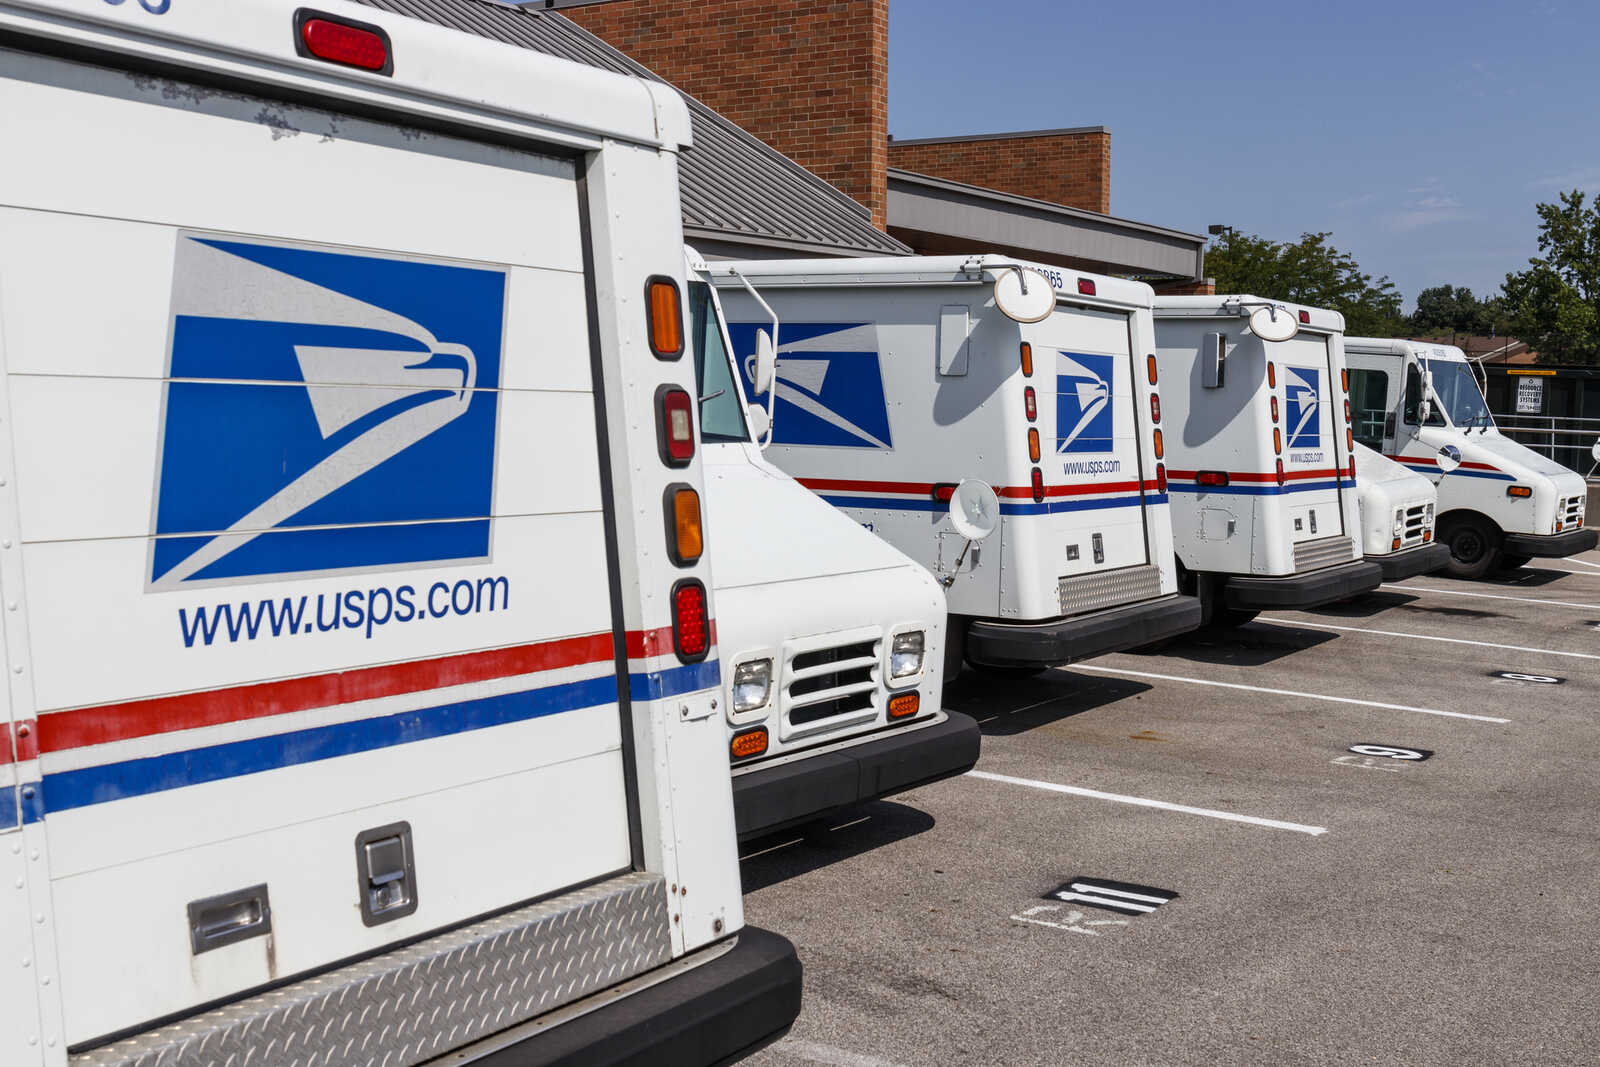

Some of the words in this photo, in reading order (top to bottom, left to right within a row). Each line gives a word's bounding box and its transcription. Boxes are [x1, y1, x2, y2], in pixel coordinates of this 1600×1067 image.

[1063, 460, 1121, 477] www.usps.com
[178, 575, 510, 648] www.usps.com
[1056, 883, 1170, 913] 11
